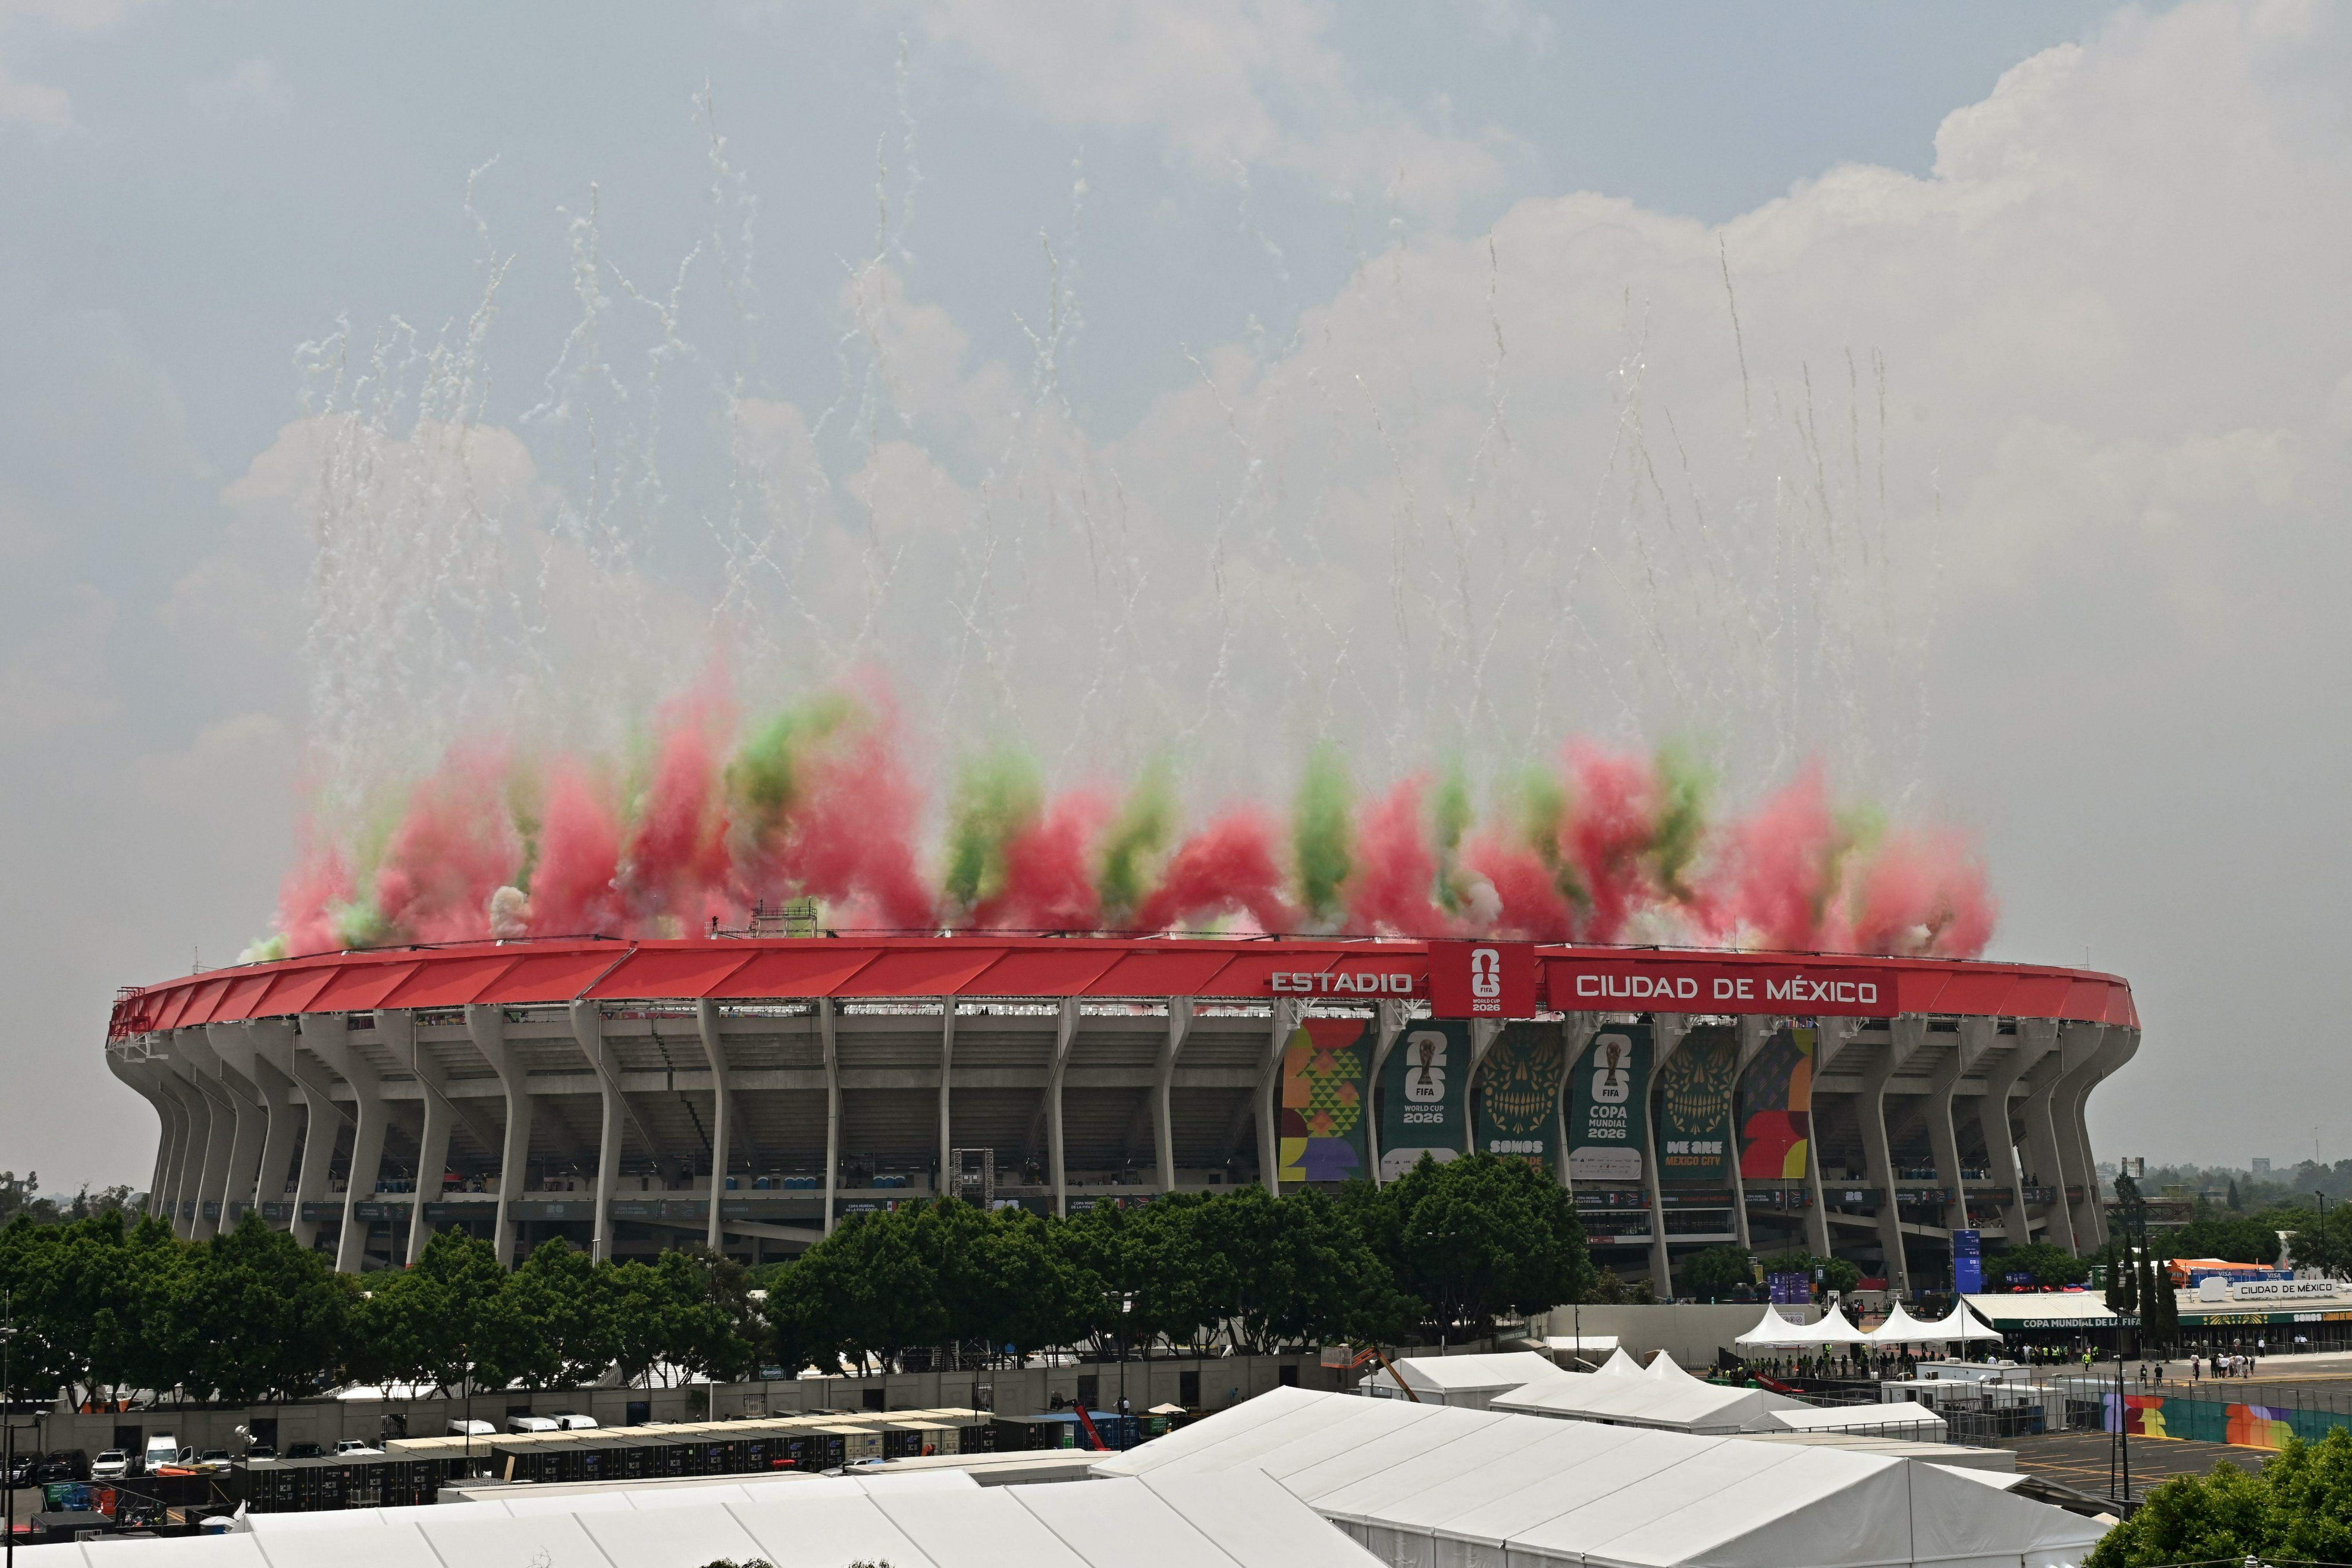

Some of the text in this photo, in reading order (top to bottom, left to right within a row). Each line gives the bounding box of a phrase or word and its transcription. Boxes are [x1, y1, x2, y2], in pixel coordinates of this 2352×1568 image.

[1272, 972, 1412, 992] ESTADIO
[1576, 975, 1876, 1004] CIUDAD DE MÉXICO
[1590, 1105, 1627, 1118] COPA
[1403, 1113, 1444, 1123] 2026
[1588, 1128, 1626, 1139] 2026
[1490, 1140, 1543, 1153] SOMOS
[1667, 1141, 1689, 1154] WE
[1701, 1156, 1721, 1166] CITY
[2241, 1286, 2278, 1294] CIUDAD
[2298, 1283, 2332, 1292] MÉXICO
[2023, 1318, 2141, 1328] COPA MUNDIAL DE LA FIFA
[2294, 1313, 2322, 1322] SOMOS
[2322, 1313, 2339, 1321] CIUDAD
[1758, 1376, 1774, 1386] mateco
